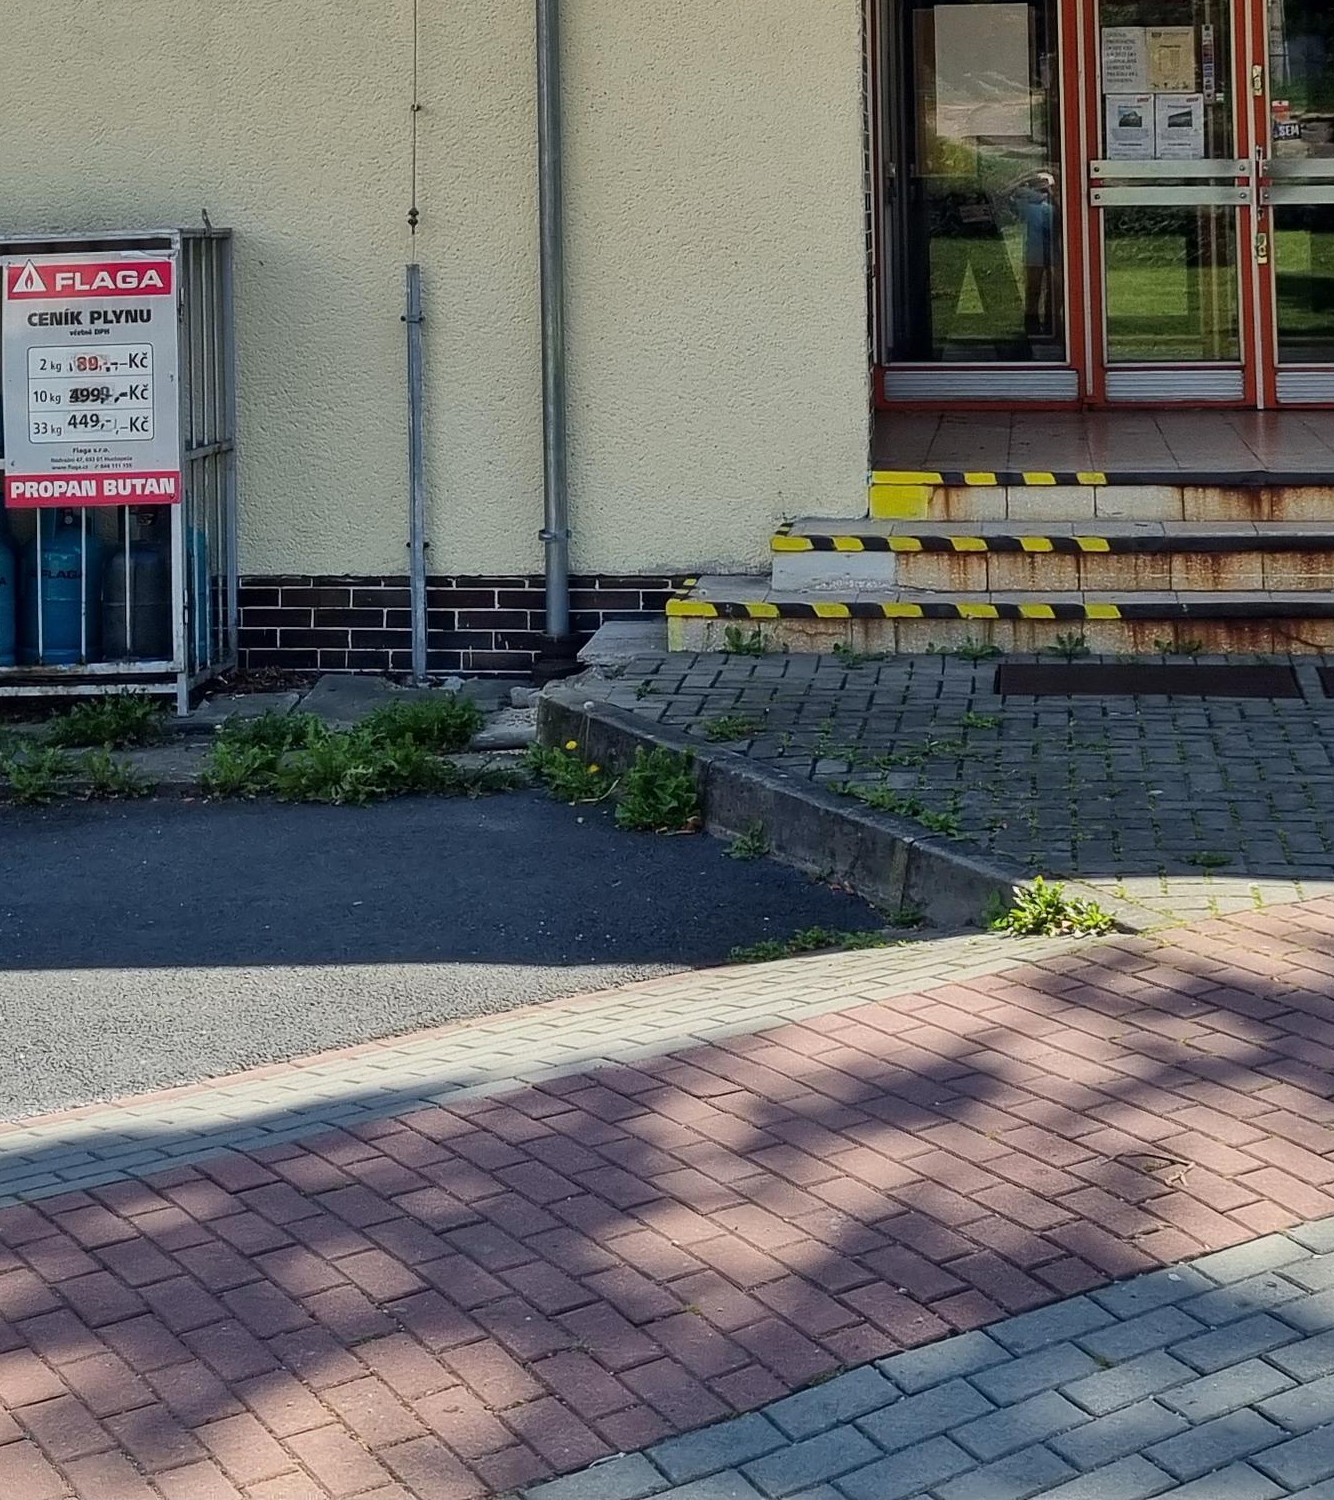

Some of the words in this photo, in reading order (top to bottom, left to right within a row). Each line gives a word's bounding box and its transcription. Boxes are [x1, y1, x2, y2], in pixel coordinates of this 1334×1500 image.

[55, 269, 164, 292] FLAGA
[27, 308, 83, 327] CENÍK
[89, 309, 152, 325] PLYNU
[94, 328, 110, 336] DPH
[39, 358, 47, 371] 2
[50, 361, 62, 373] kg
[33, 390, 48, 403] 10
[49, 392, 62, 404] kg
[33, 422, 48, 435] 33
[50, 424, 62, 437] kg
[10, 479, 97, 499] PROPAN
[103, 477, 175, 496] BUTAN
